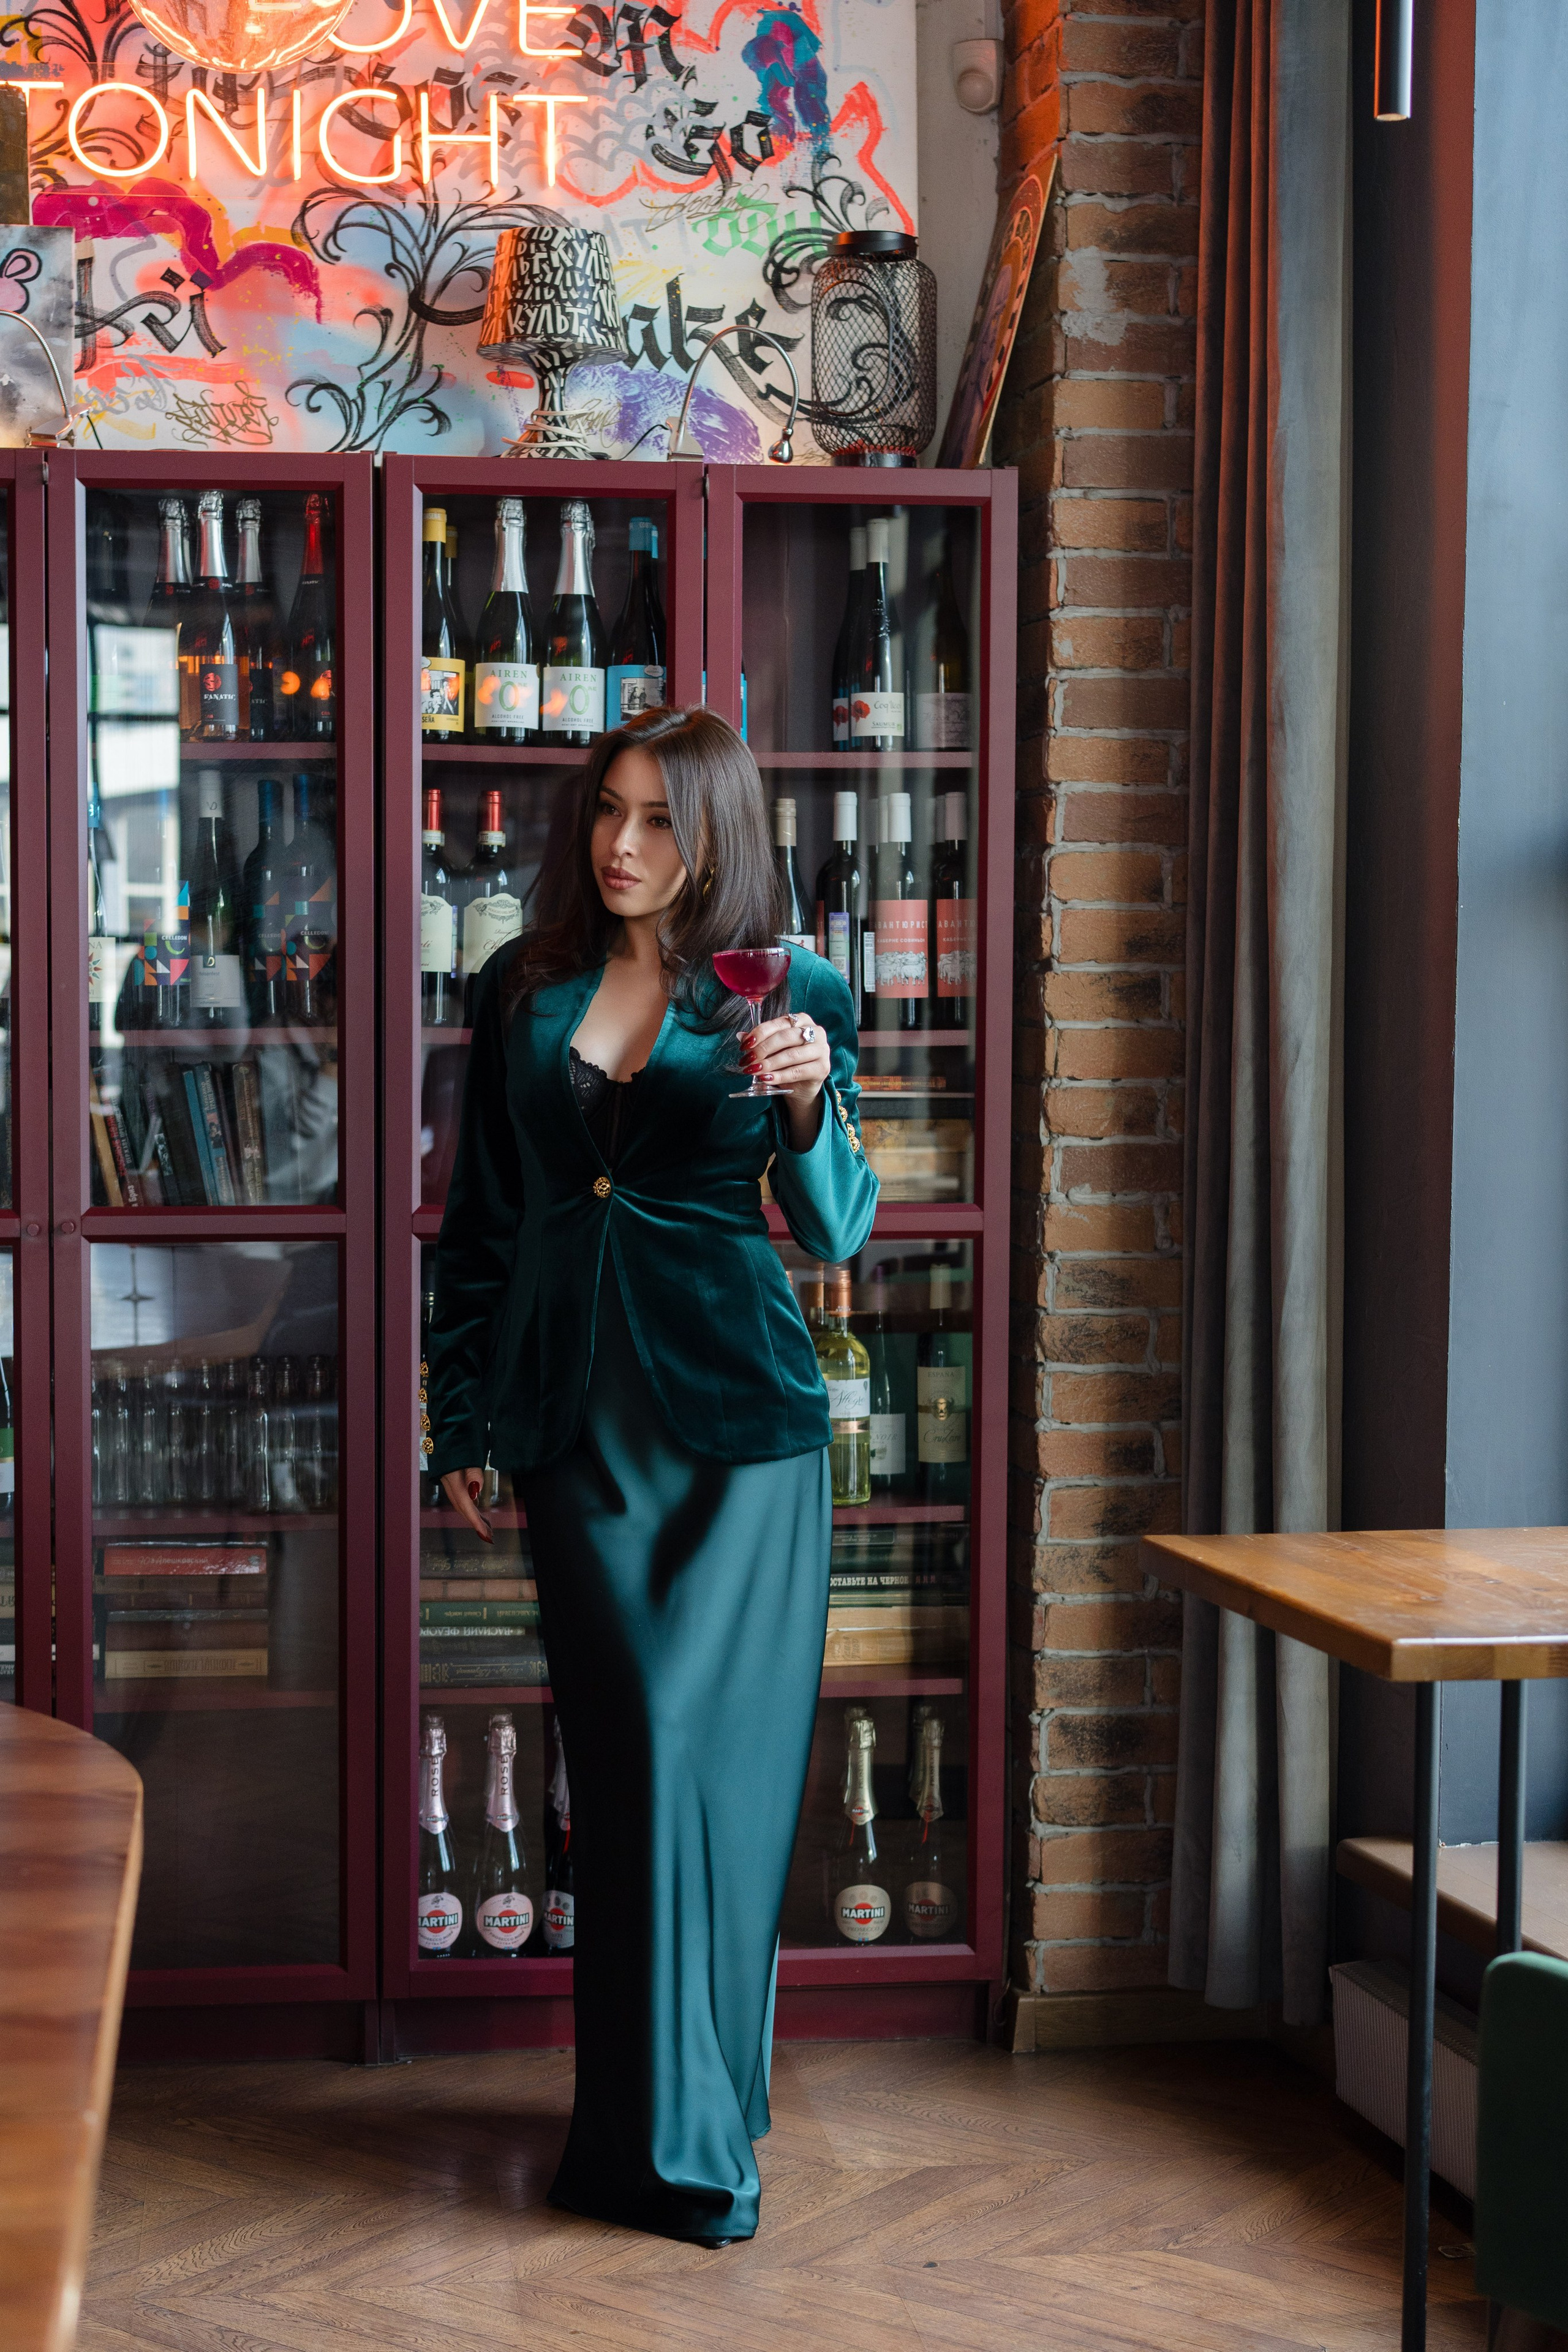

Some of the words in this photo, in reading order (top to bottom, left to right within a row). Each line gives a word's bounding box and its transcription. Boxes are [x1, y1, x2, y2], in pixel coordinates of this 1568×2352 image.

[490, 669, 527, 678] AIREN
[560, 674, 597, 682] AIREN
[867, 1577, 878, 1586] НА
[463, 1626, 511, 1636] ВАСИЛИЙ
[842, 1907, 884, 1918] MARTINI
[908, 1904, 949, 1915] MARTINI
[484, 1913, 529, 1927] MARTINI
